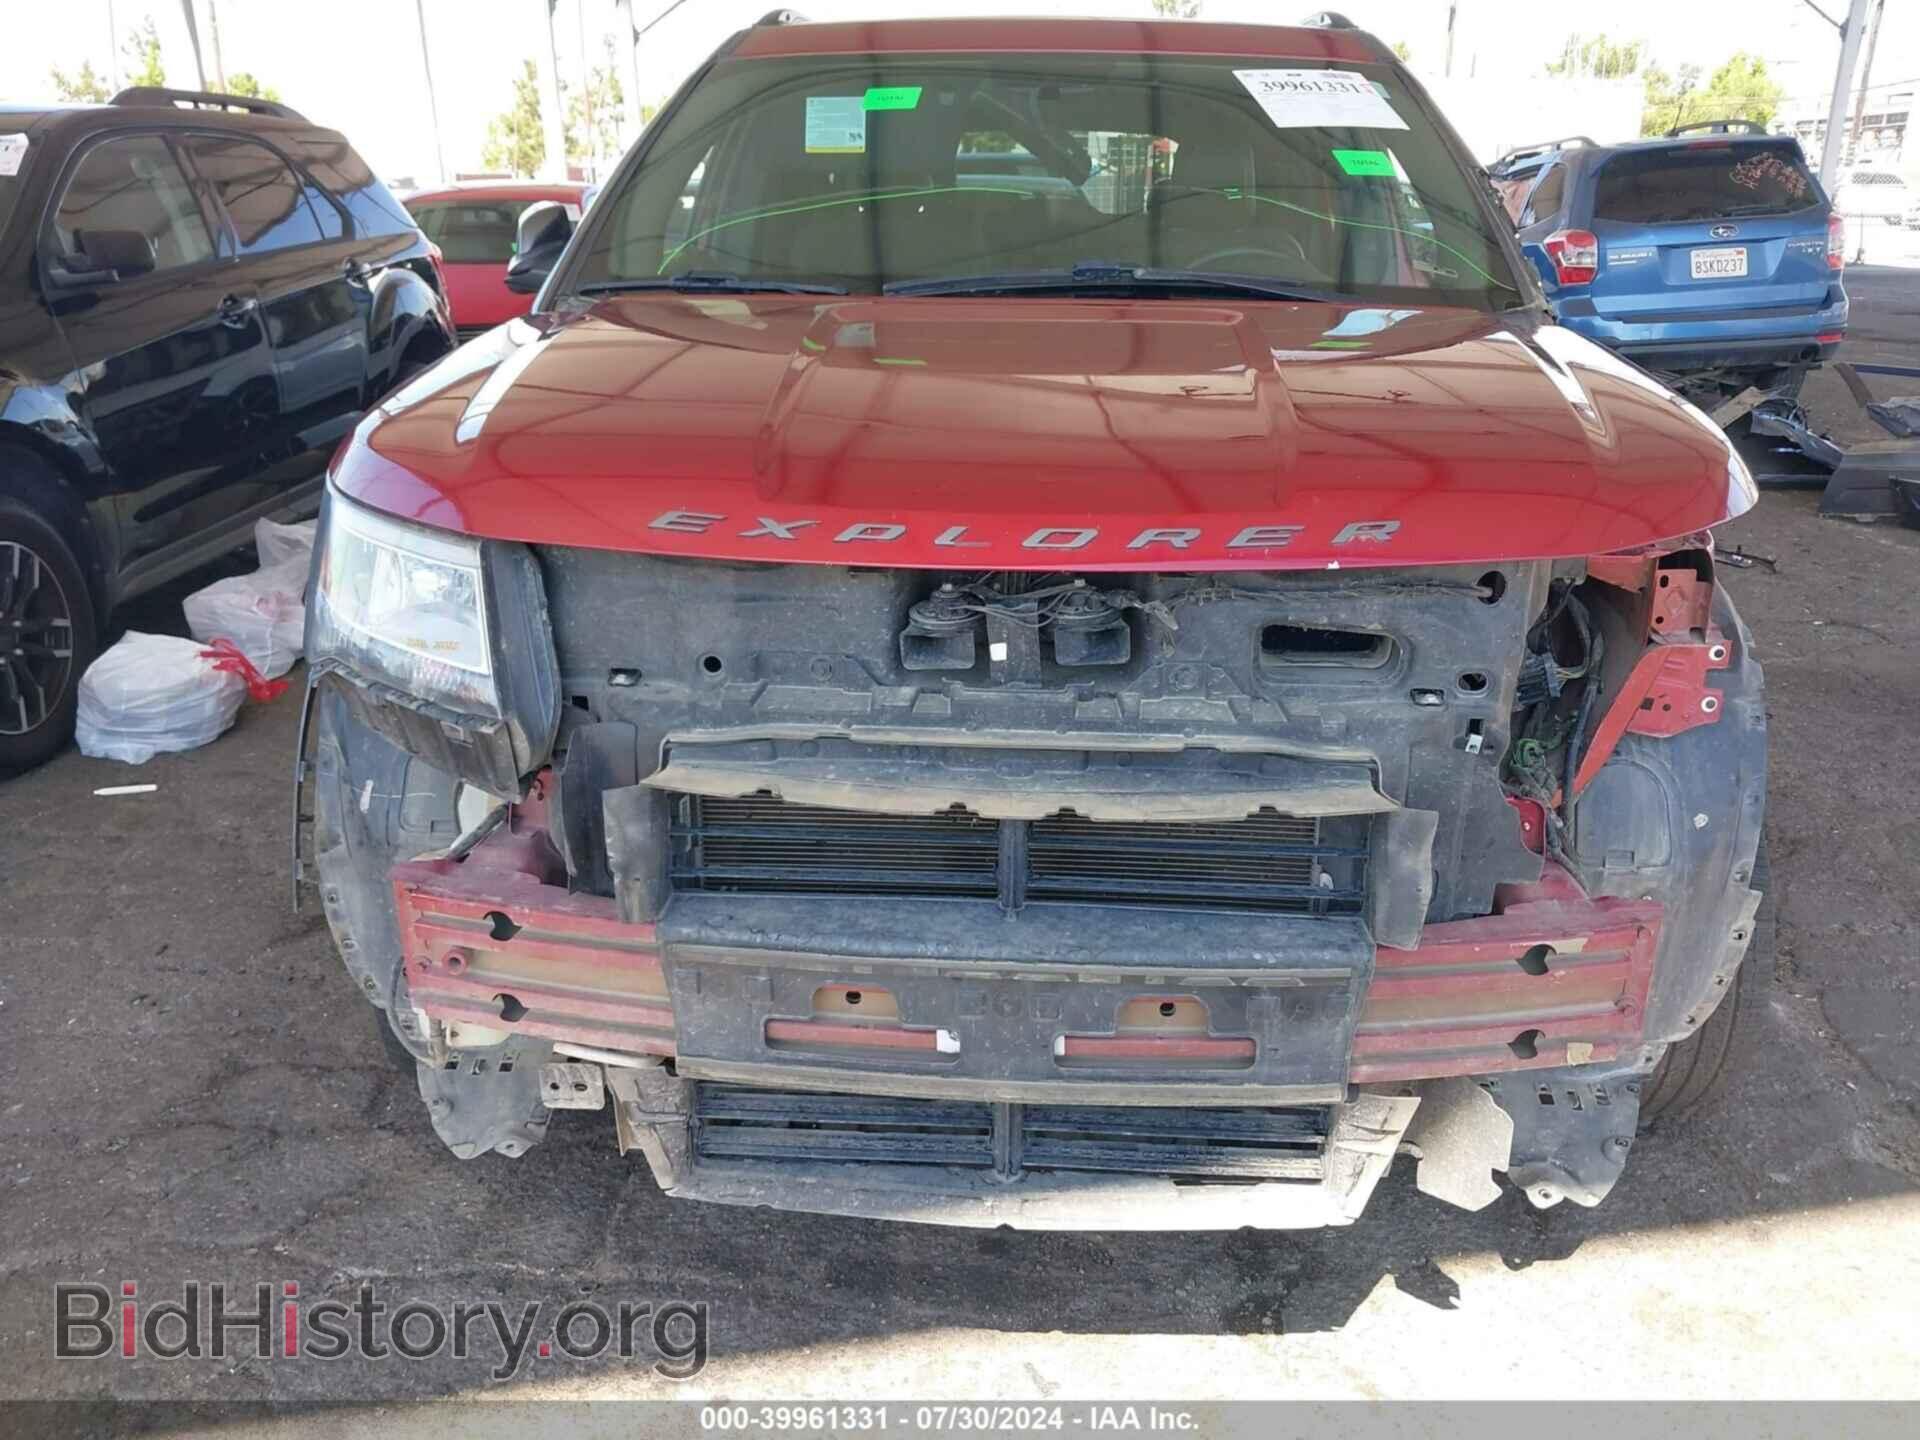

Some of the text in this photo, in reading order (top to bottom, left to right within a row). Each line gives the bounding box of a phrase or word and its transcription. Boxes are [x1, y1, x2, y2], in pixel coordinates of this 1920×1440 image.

[1260, 79, 1361, 95] 39961331
[1695, 258, 1744, 274] 8SKD237
[649, 512, 1401, 551] EXPLORER
